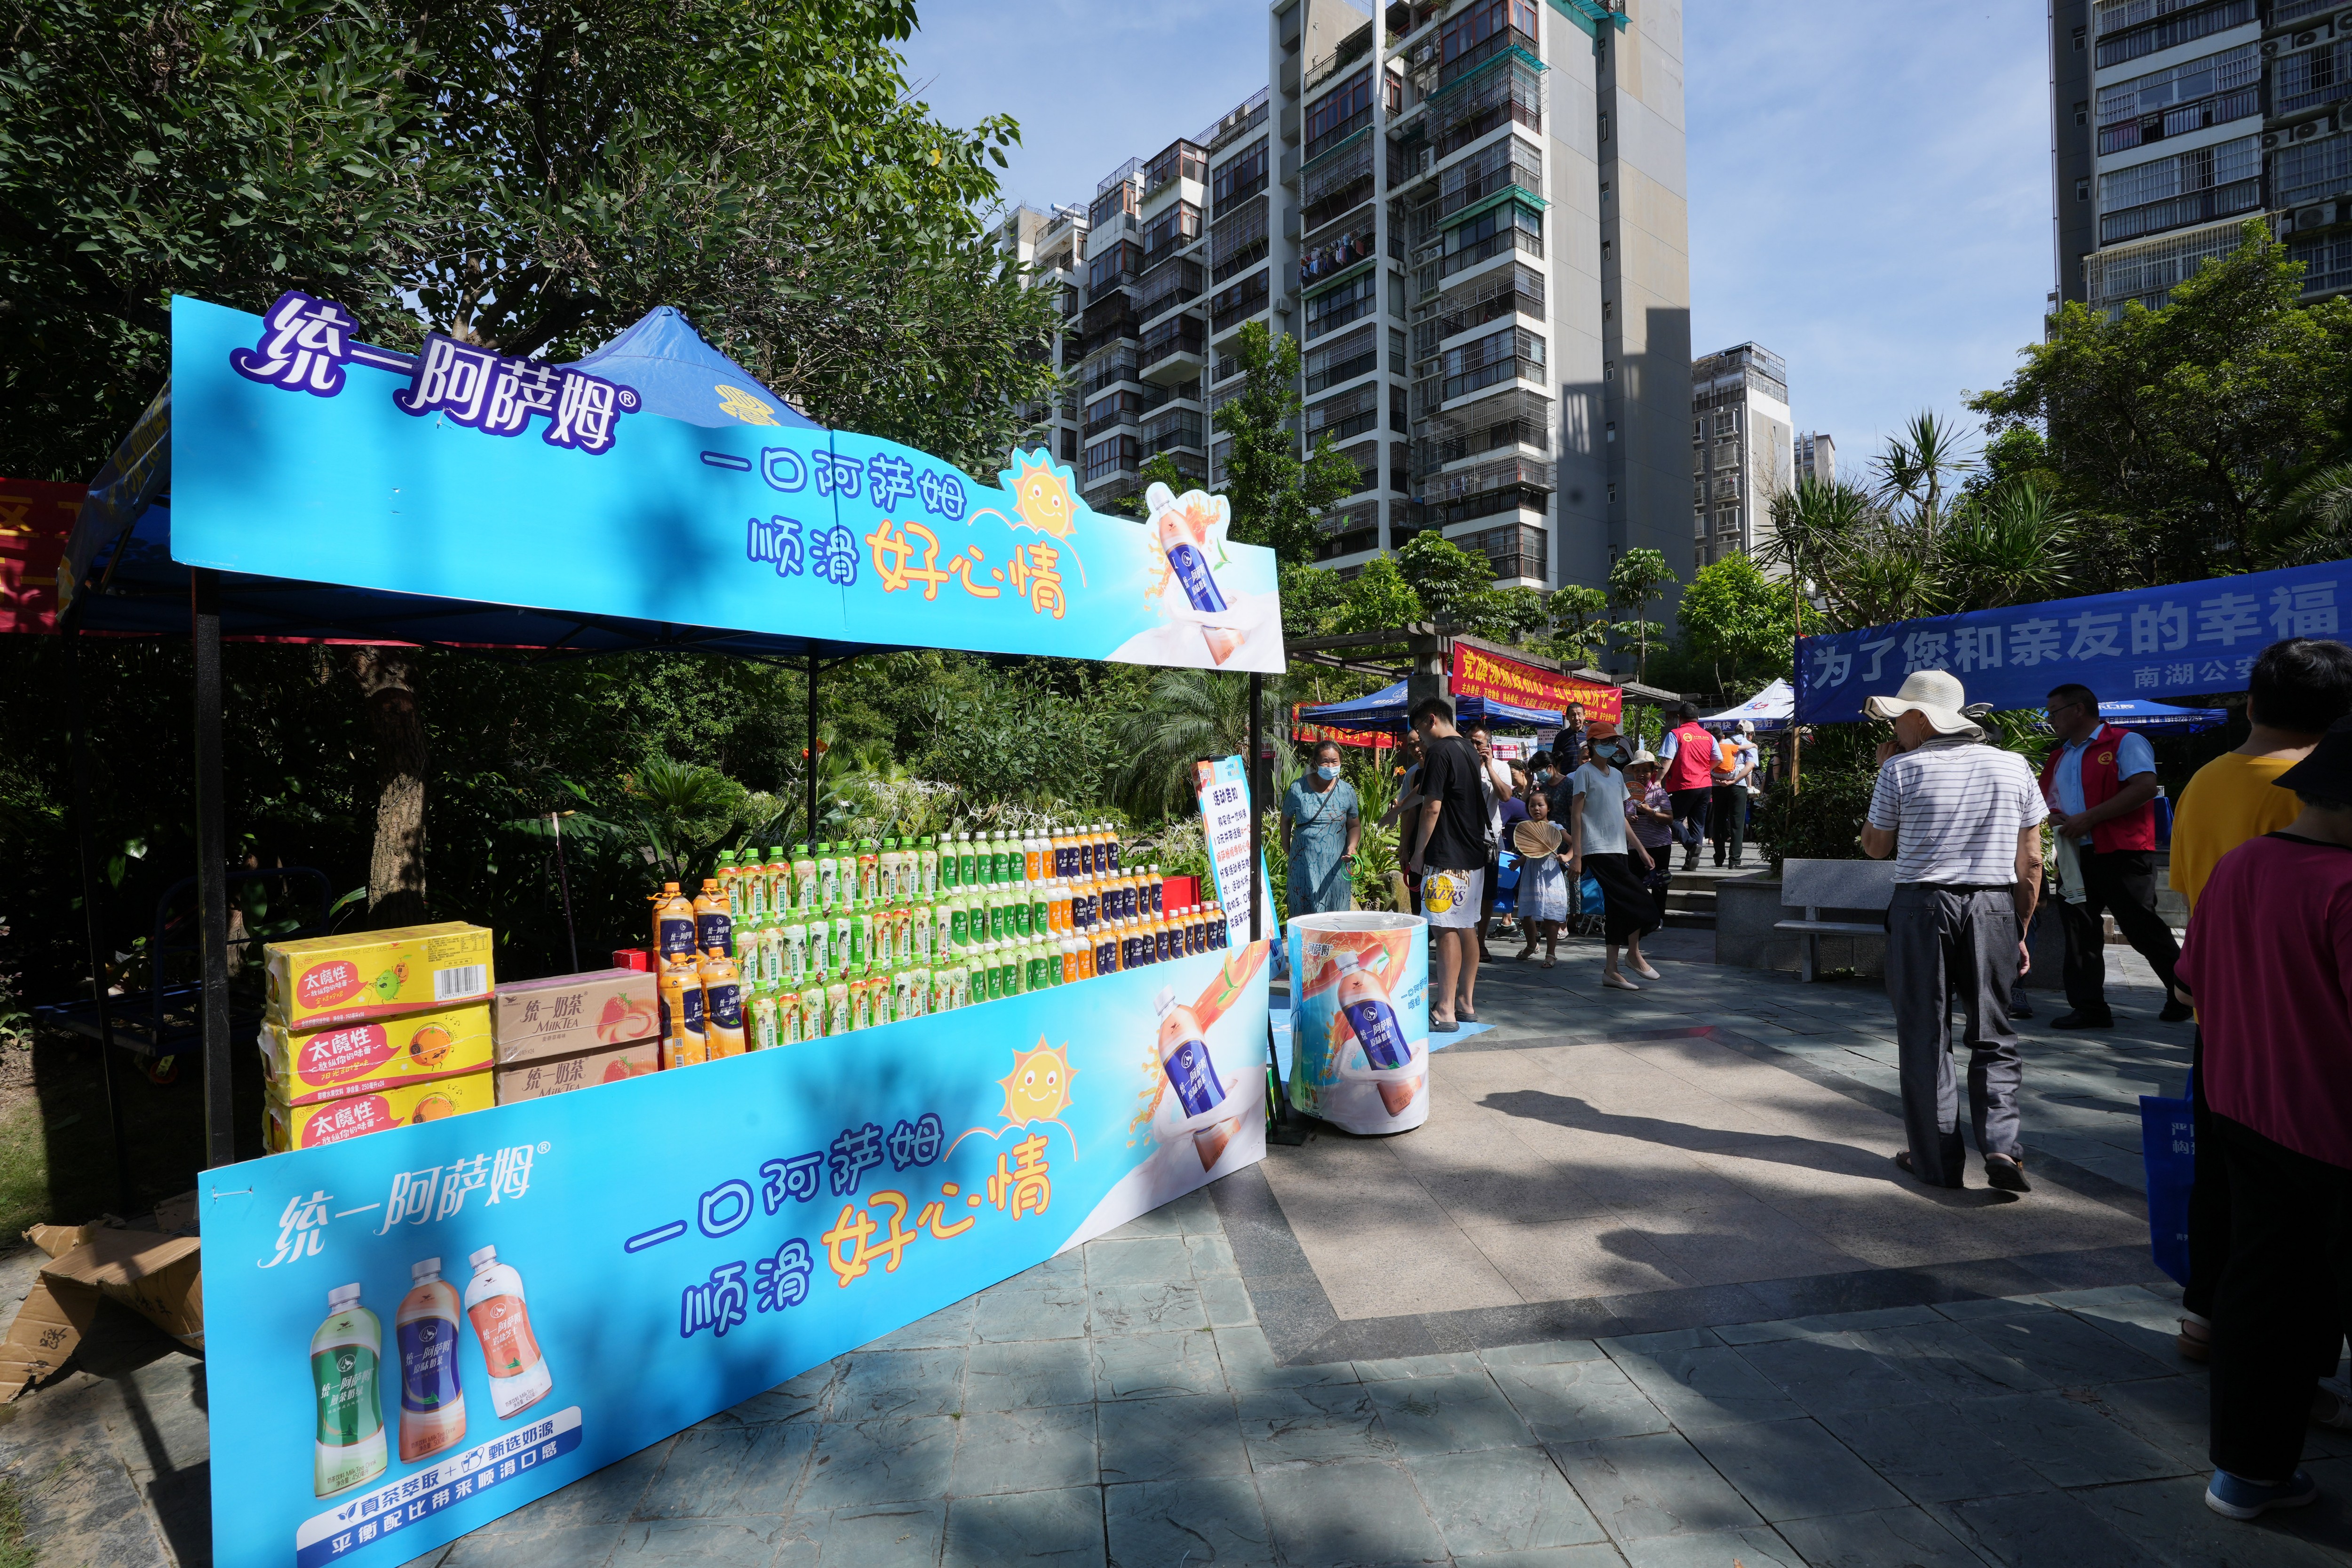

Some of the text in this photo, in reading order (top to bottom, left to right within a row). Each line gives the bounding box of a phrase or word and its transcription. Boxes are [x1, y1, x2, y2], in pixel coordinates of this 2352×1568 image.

[239, 297, 616, 448] 统一阿萨姆
[701, 447, 966, 521] 一口阿萨姆
[747, 515, 1066, 620] 顺滑好心情
[1812, 580, 2338, 689] 为了您和亲友的幸福
[2133, 656, 2256, 688] 南湖公安
[1743, 702, 1769, 710] 5G
[1703, 719, 1773, 730] 网速快 务好
[1213, 787, 1238, 805] 活动告知
[1421, 883, 1467, 906] LAKERS
[1301, 941, 1330, 956] 一阿萨姆
[304, 965, 348, 990] 太魔性
[311, 979, 347, 996] 放纵你的味蕾
[316, 991, 344, 1005] 金桔柠檬
[520, 994, 584, 1023] 统一奶茶
[309, 1027, 372, 1062] 太魔性
[1370, 1031, 1391, 1047] 原味奶茶
[318, 1046, 371, 1071] 放纵你的味蕾
[321, 1059, 369, 1080] 阳光甜橙味
[522, 1059, 586, 1091] 统一奶茶
[318, 1090, 344, 1099] 甜橙水果饮料
[312, 1101, 375, 1137] 太魔性
[322, 1119, 374, 1145] 放纵你的味蕾
[2171, 1122, 2195, 1137] 严
[2172, 1139, 2195, 1155] 构
[625, 1112, 942, 1254] 一口阿萨姆
[257, 1144, 533, 1268] 统一阿萨姆
[681, 1131, 1051, 1338] 顺滑好心情
[493, 1326, 518, 1346] 岩盐芝士
[405, 1339, 451, 1366] 统一阿萨姆
[413, 1355, 443, 1375] 原味奶茶
[321, 1369, 371, 1399] 统一阿萨姆
[329, 1387, 364, 1407] 煎茶奶绿
[327, 1472, 344, 1485] 奶茶饮料
[366, 1459, 376, 1469] Drink
[361, 1420, 553, 1517] 真茶萃取 甄选奶源
[331, 1441, 557, 1554] 平衡配比带来顺滑口感
